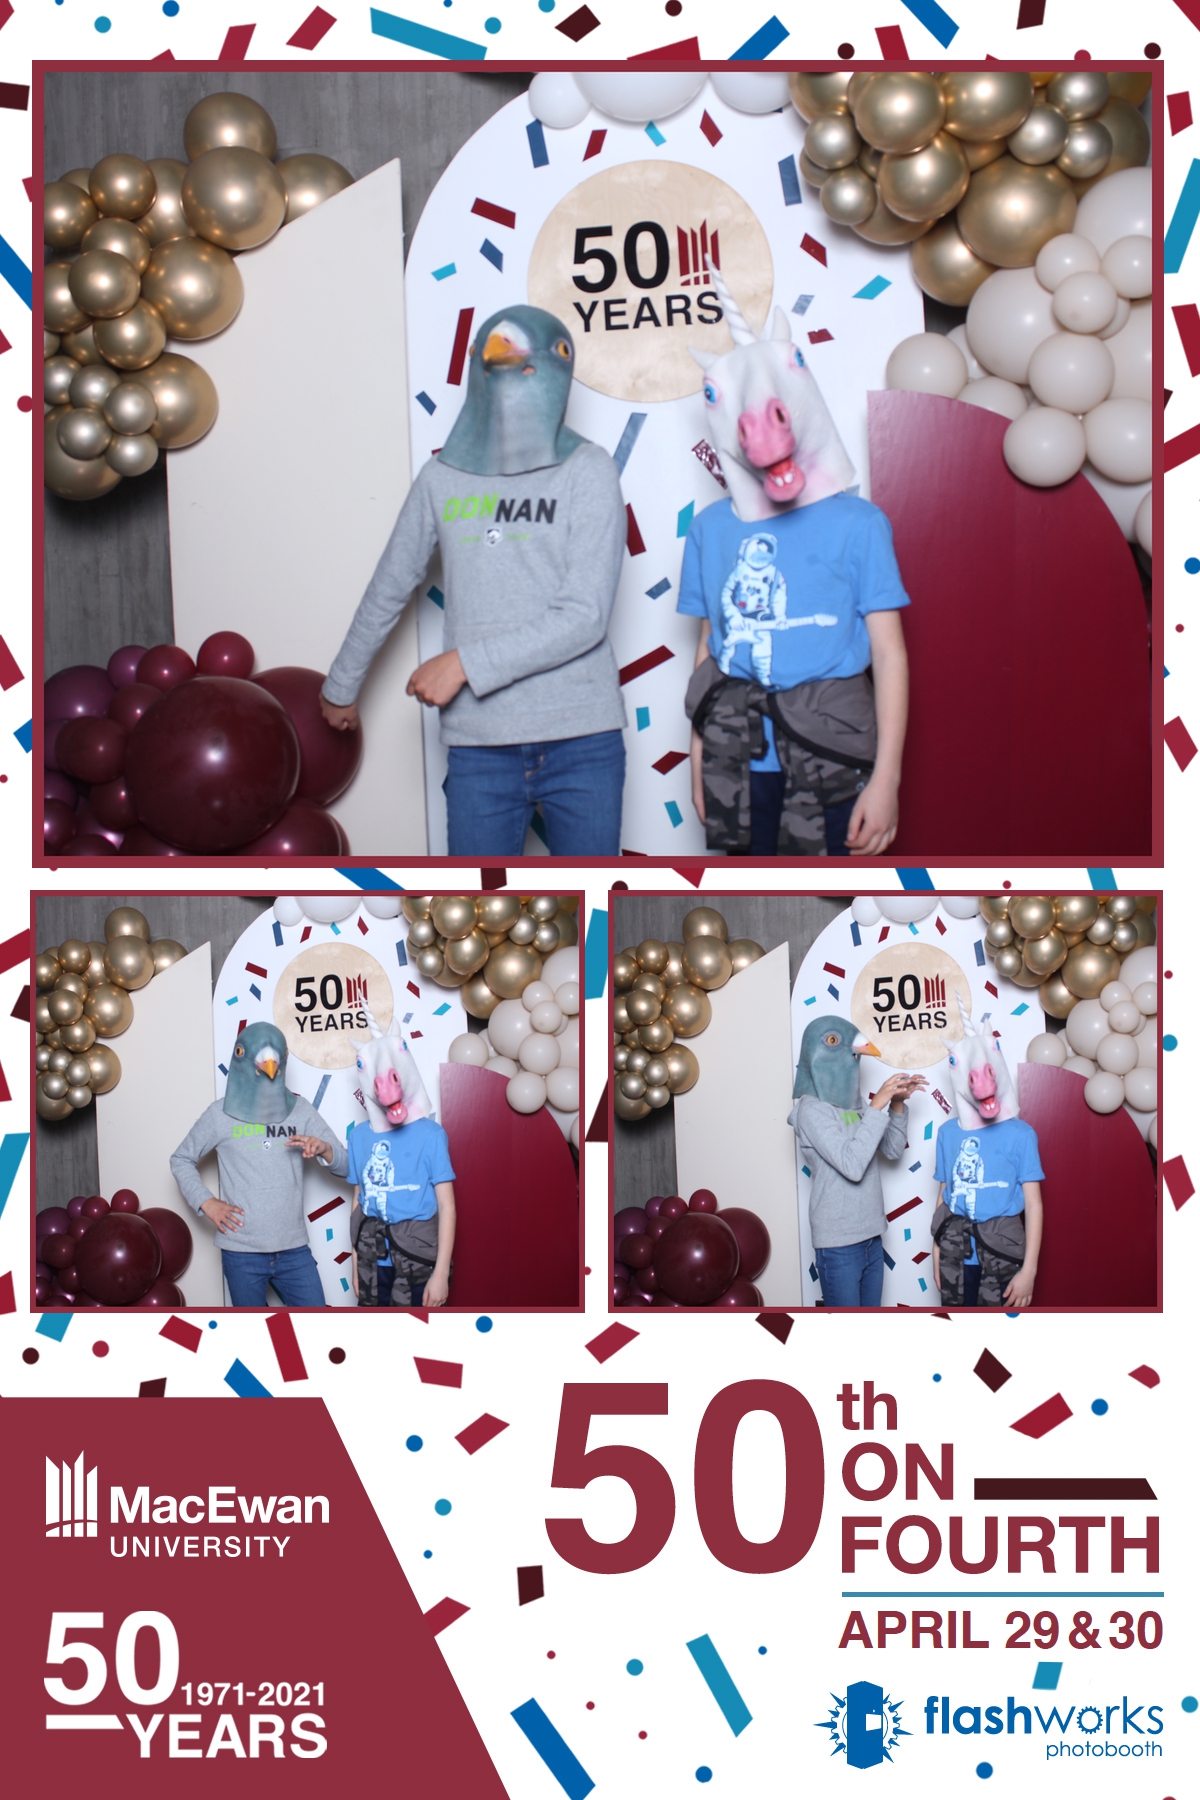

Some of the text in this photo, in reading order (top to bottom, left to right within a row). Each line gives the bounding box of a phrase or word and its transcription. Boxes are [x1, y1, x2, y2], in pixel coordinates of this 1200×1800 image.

[571, 220, 670, 294] 50
[572, 291, 724, 333] YEARS
[442, 492, 558, 524] DONNAN
[294, 973, 344, 1013] 50
[872, 973, 922, 1013] 50
[294, 1011, 369, 1033] YEARS
[872, 1010, 948, 1033] YEARS
